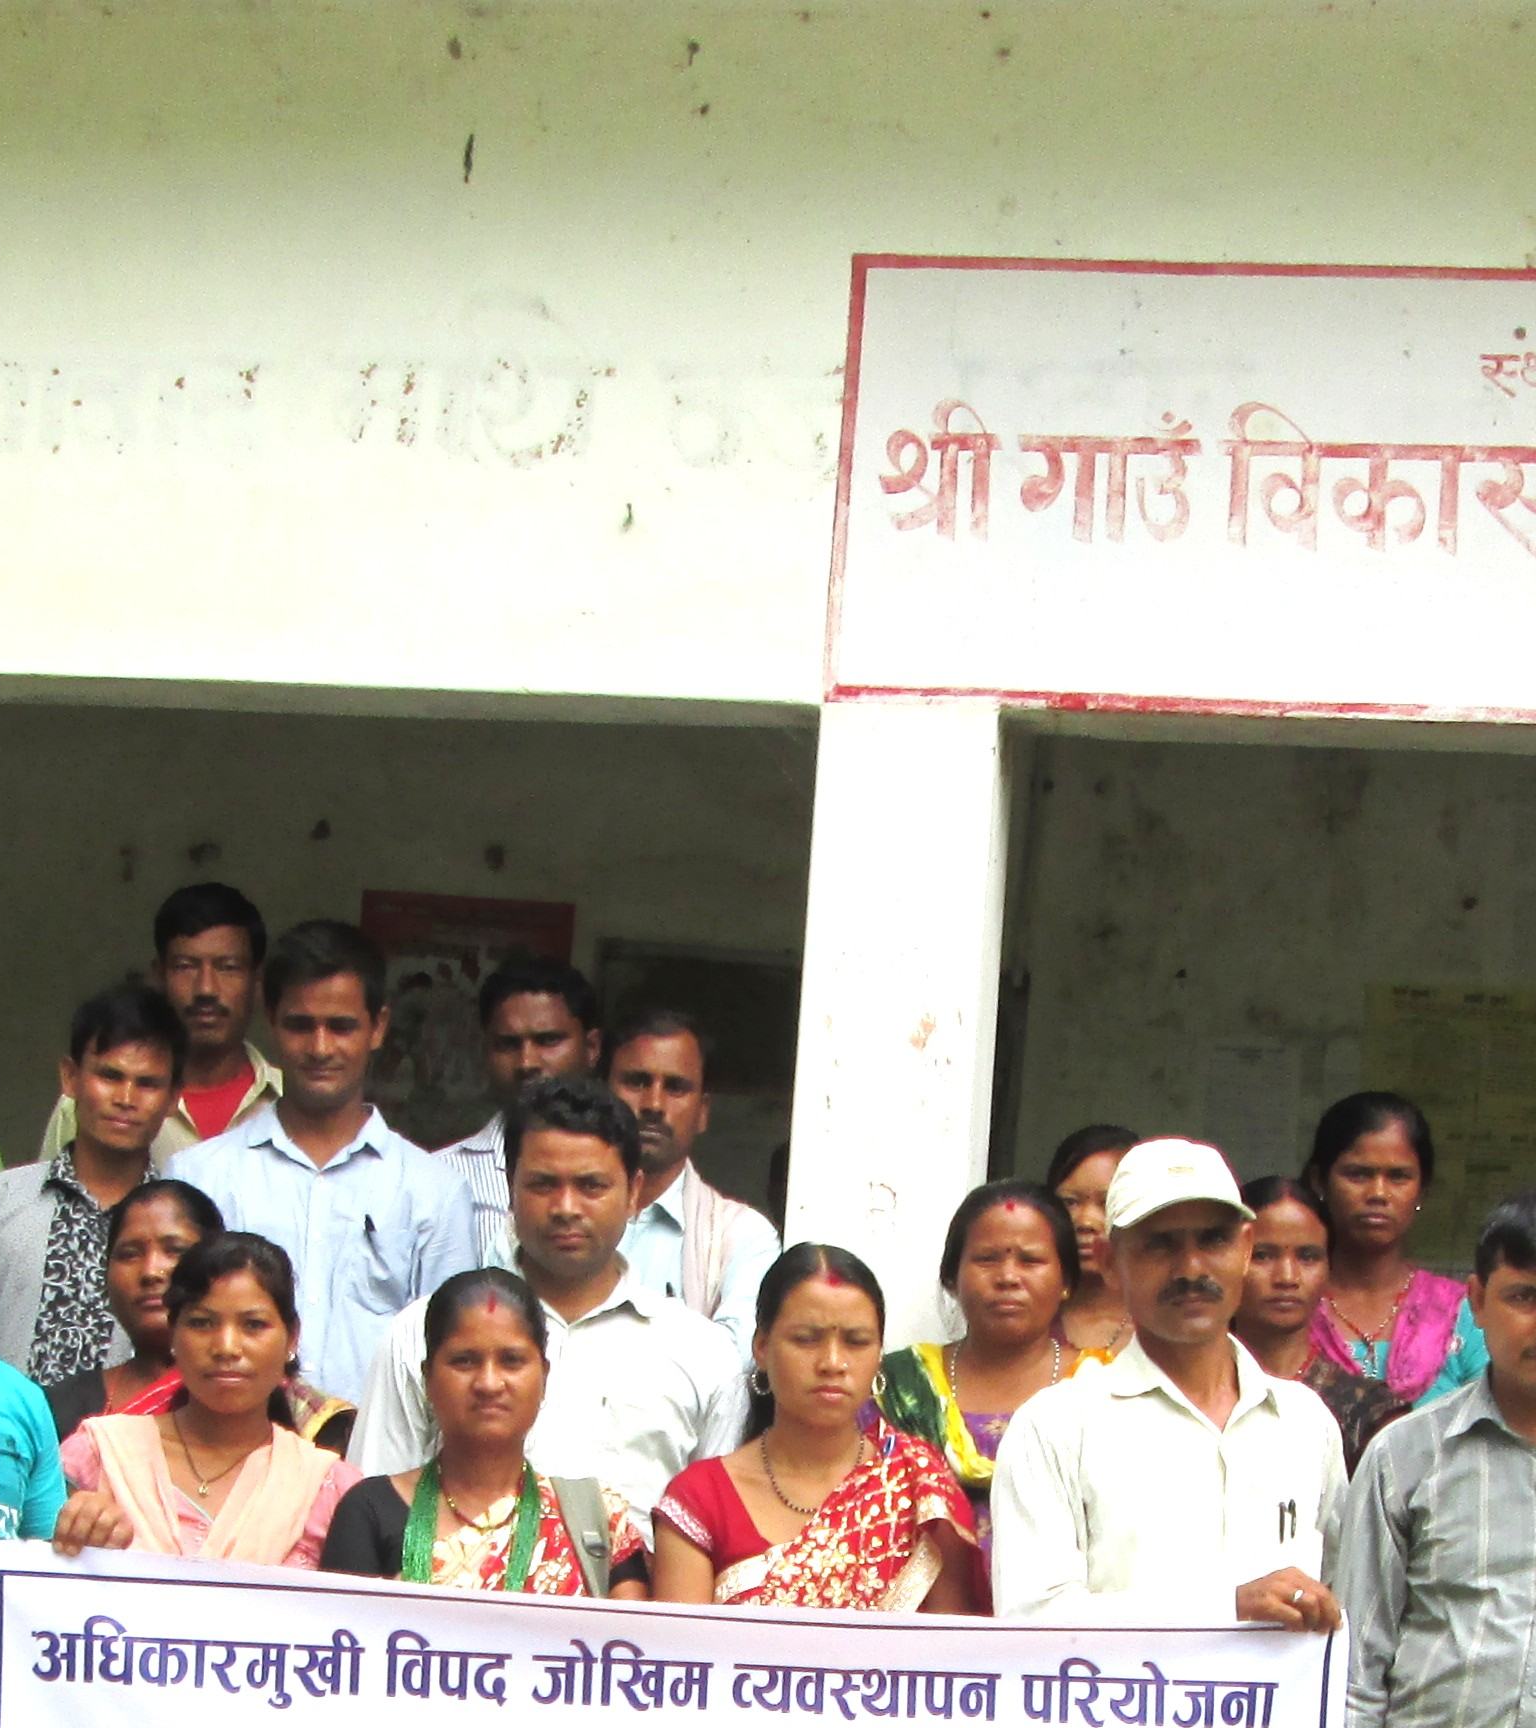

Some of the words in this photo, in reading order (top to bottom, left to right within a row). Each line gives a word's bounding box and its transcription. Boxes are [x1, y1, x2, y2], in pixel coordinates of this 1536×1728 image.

[879, 397, 1000, 544] श्री
[1018, 411, 1202, 546] गाउँ
[30, 1615, 366, 1711] अधिकारमुखी
[384, 1628, 510, 1707] विपद
[531, 1638, 714, 1713] जोखिम
[731, 1662, 1002, 1723] व्यवस्थापन
